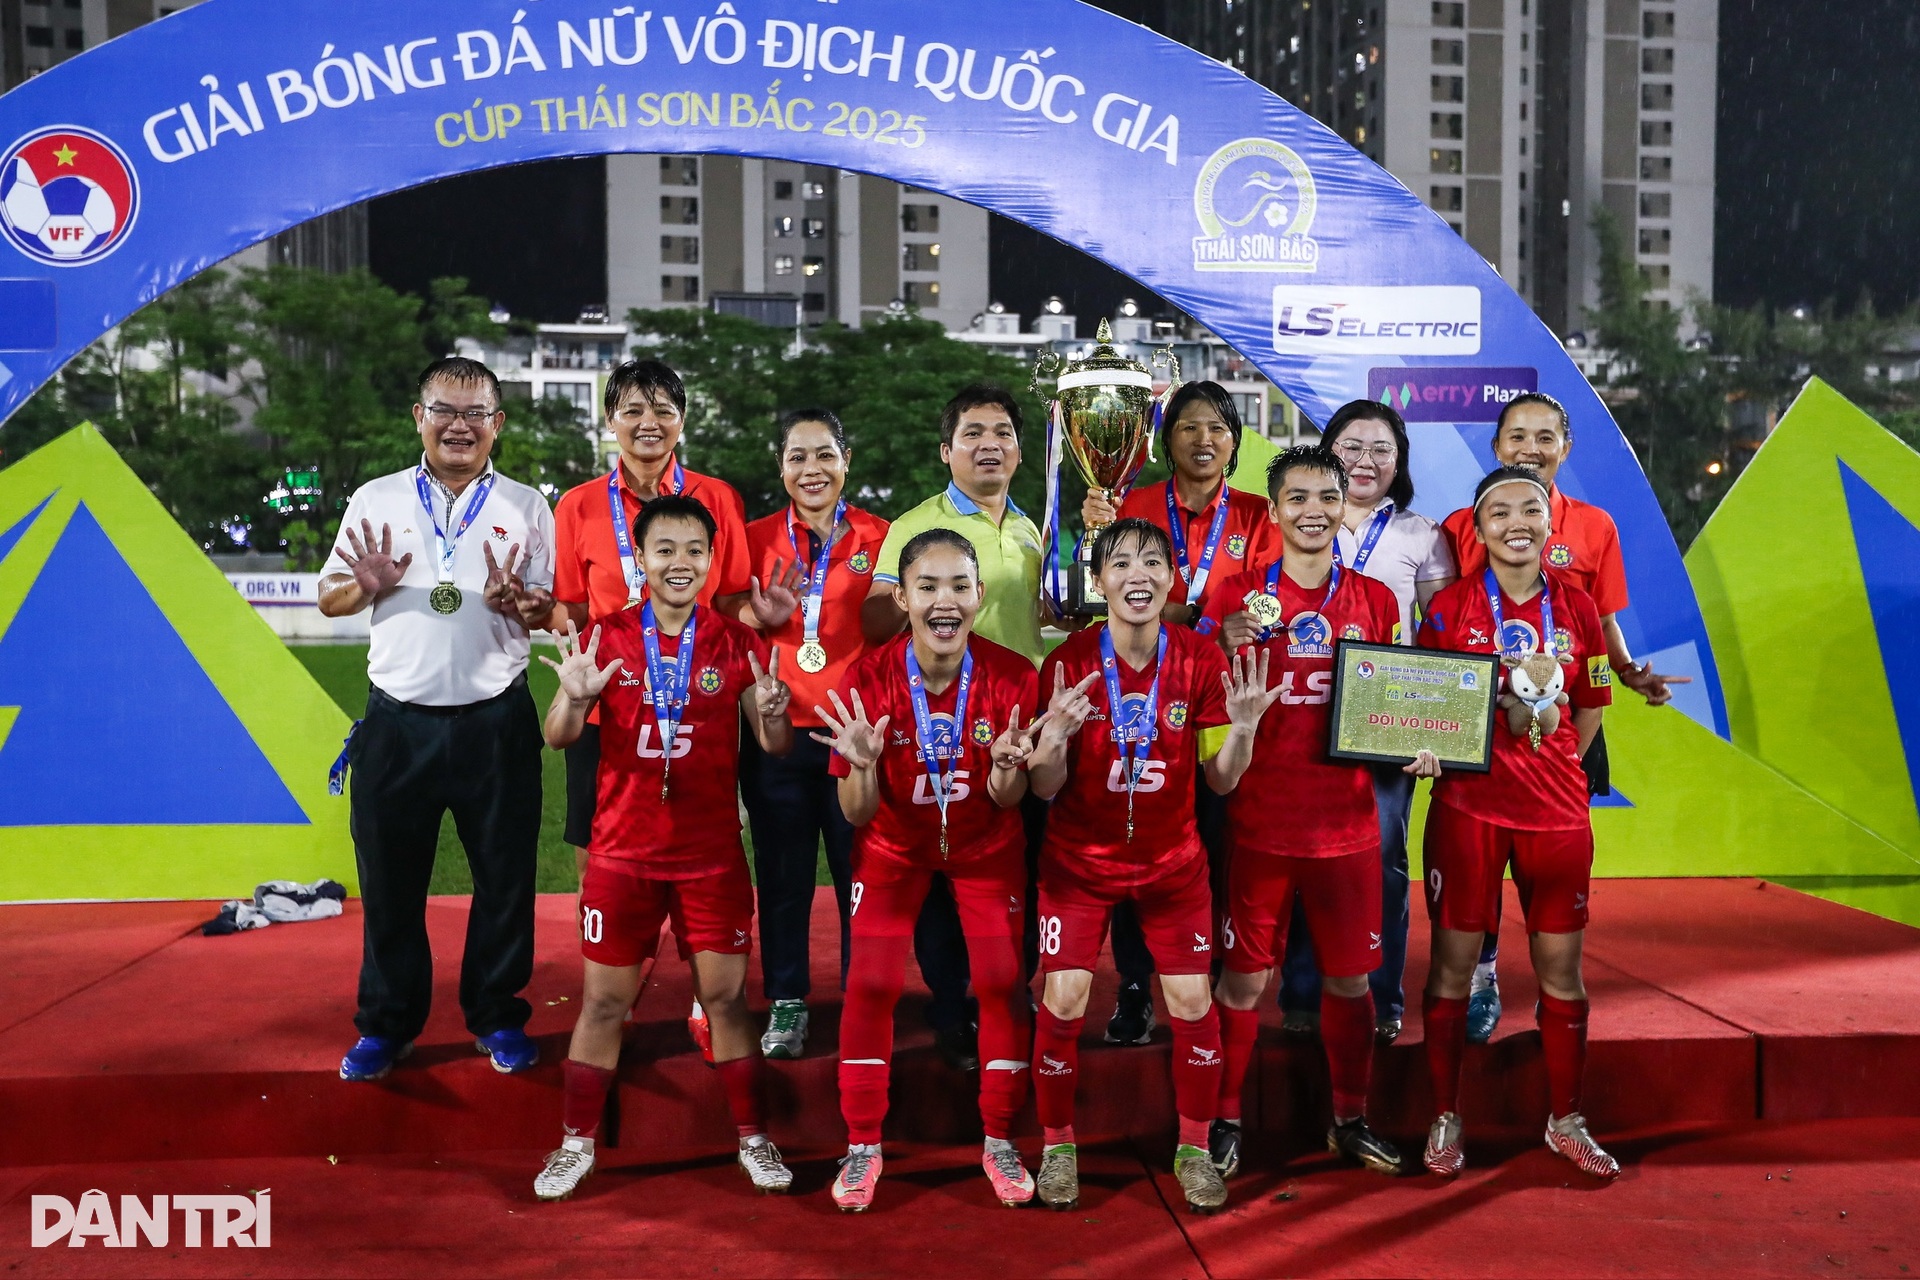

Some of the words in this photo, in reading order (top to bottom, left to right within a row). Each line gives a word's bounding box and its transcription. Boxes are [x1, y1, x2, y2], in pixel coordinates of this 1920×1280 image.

[143, 75, 265, 163] GIẢI
[266, 37, 446, 123] BÓNG
[453, 9, 547, 81] ĐÁ
[557, 6, 651, 69] NỮ
[662, 2, 746, 66] VÔ
[757, 20, 905, 83] ĐỊCH
[914, 42, 1086, 124] QUỐC
[1091, 92, 1181, 166] GIA
[435, 98, 522, 148] CÚP
[531, 84, 628, 133] THÁI
[637, 90, 721, 127] SƠN
[729, 79, 815, 132] BẮC
[822, 101, 927, 150] 2025
[49, 227, 84, 241] VFF
[1198, 232, 1235, 260] THÁI
[1240, 233, 1275, 260] SƠN
[1279, 233, 1313, 261] BẮC
[618, 530, 629, 547] VFF
[1203, 545, 1215, 561] VFF
[1358, 549, 1370, 563] VFF
[815, 569, 825, 585] VFF
[1491, 595, 1499, 612] VFF
[682, 627, 692, 645] VFF
[961, 671, 969, 691] VFF
[655, 690, 665, 709] VFF
[1404, 691, 1417, 699] LS
[1368, 712, 1395, 729] ĐỘI
[1399, 715, 1420, 728] VÔ
[1424, 719, 1460, 734] ĐỊCH
[636, 724, 694, 759] LS
[1116, 725, 1125, 745] VFF
[924, 743, 935, 762] VFF
[1106, 759, 1167, 793] LS
[912, 770, 970, 805] LS
[1430, 868, 1443, 902] 9
[583, 905, 603, 944] 10
[1039, 915, 1062, 955] 88
[1187, 1057, 1221, 1066] KAMITO
